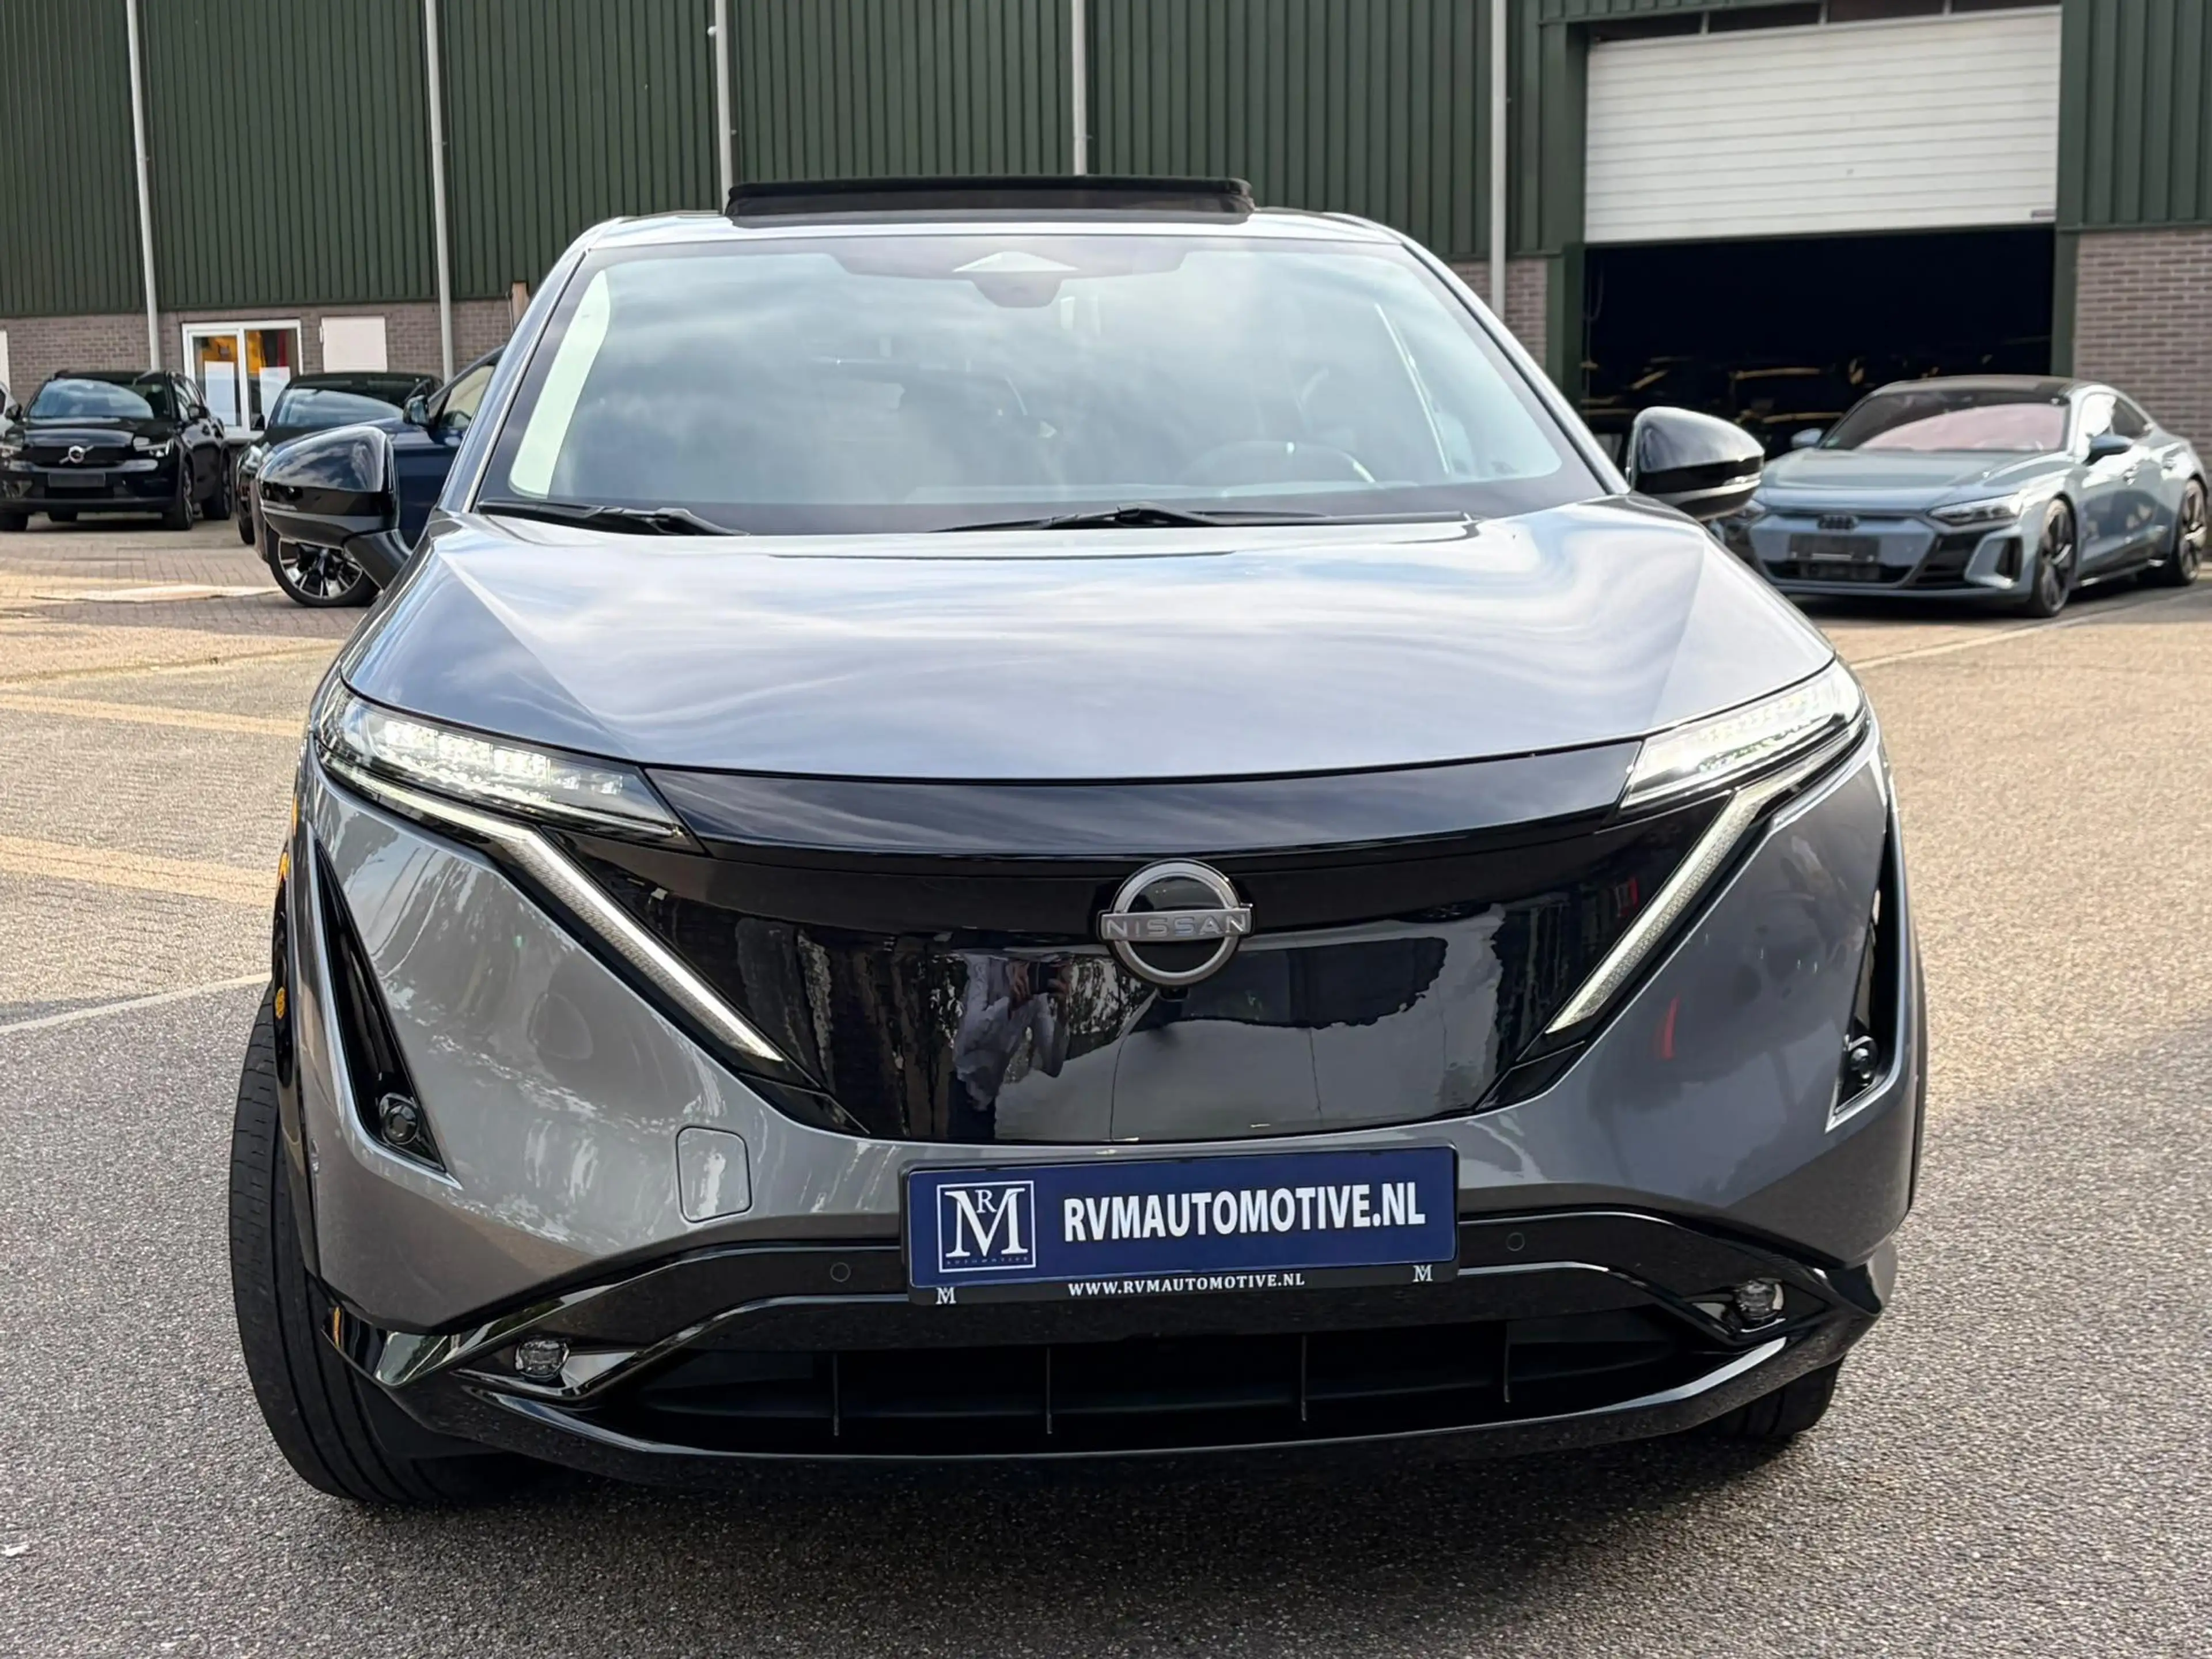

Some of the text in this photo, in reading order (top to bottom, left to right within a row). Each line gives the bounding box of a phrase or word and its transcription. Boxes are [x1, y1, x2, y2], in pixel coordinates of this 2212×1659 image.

[1106, 914, 1247, 938] NISSAN
[1063, 1181, 1426, 1242] RVMAUTOMOTIVE.NL
[1067, 1272, 1305, 1297] WWW.RVMAUTOMOTIVE.NL
